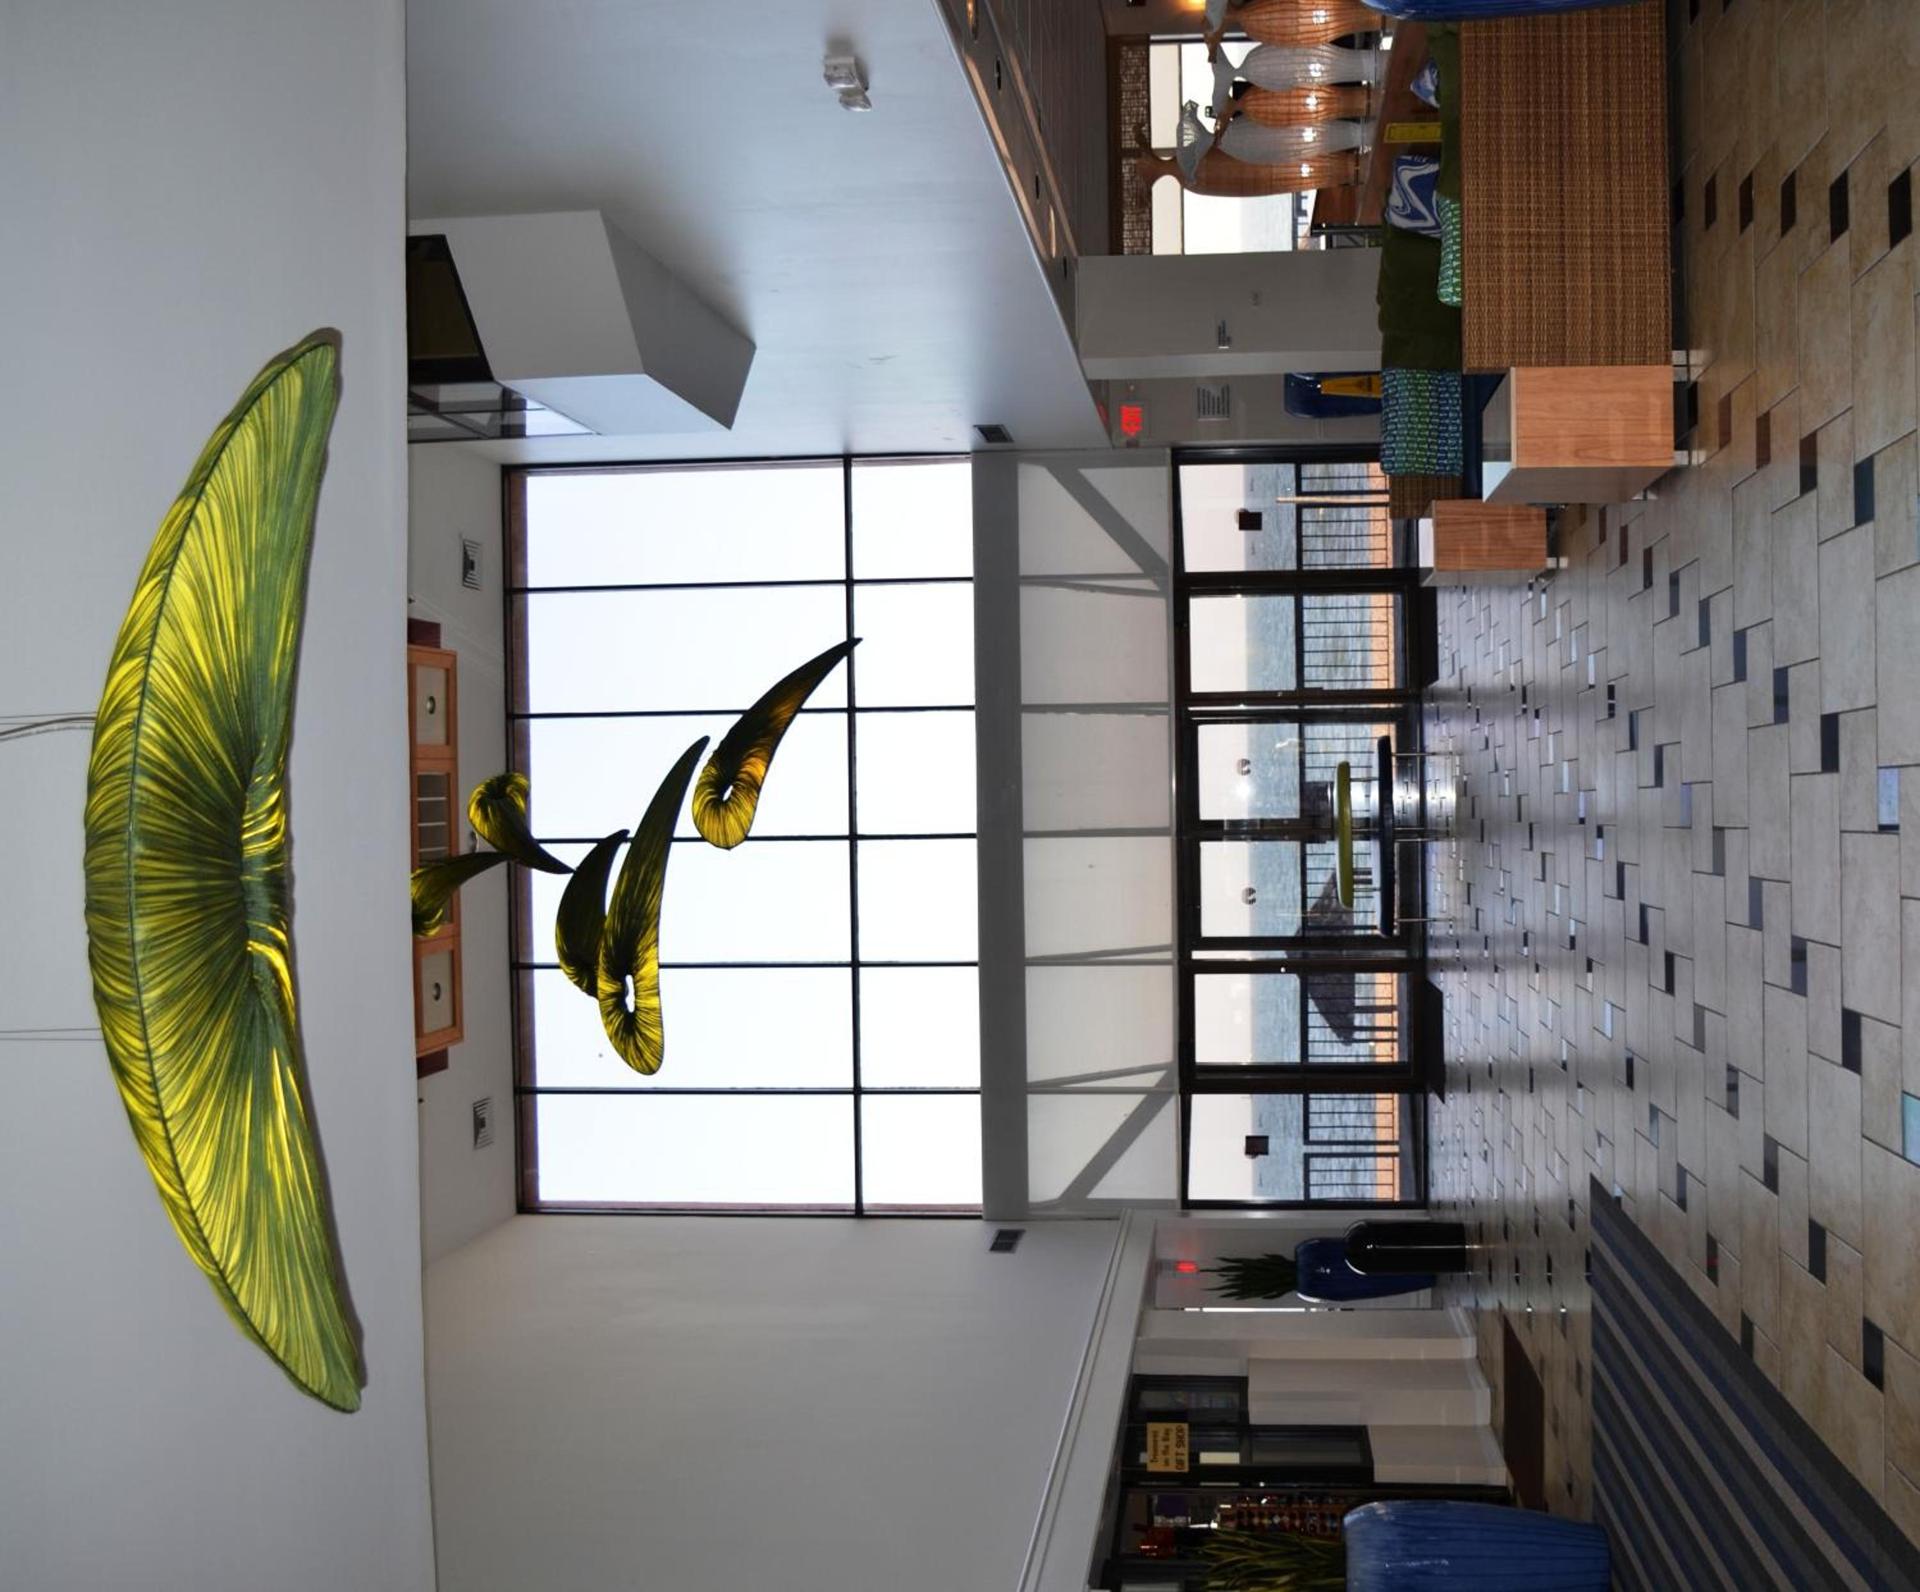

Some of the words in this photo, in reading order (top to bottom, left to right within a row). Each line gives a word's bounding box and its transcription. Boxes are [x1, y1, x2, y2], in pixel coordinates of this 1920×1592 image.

[1120, 405, 1143, 431] EXIT
[1175, 1425, 1185, 1449] SHOP
[1175, 1452, 1185, 1470] GIFT
